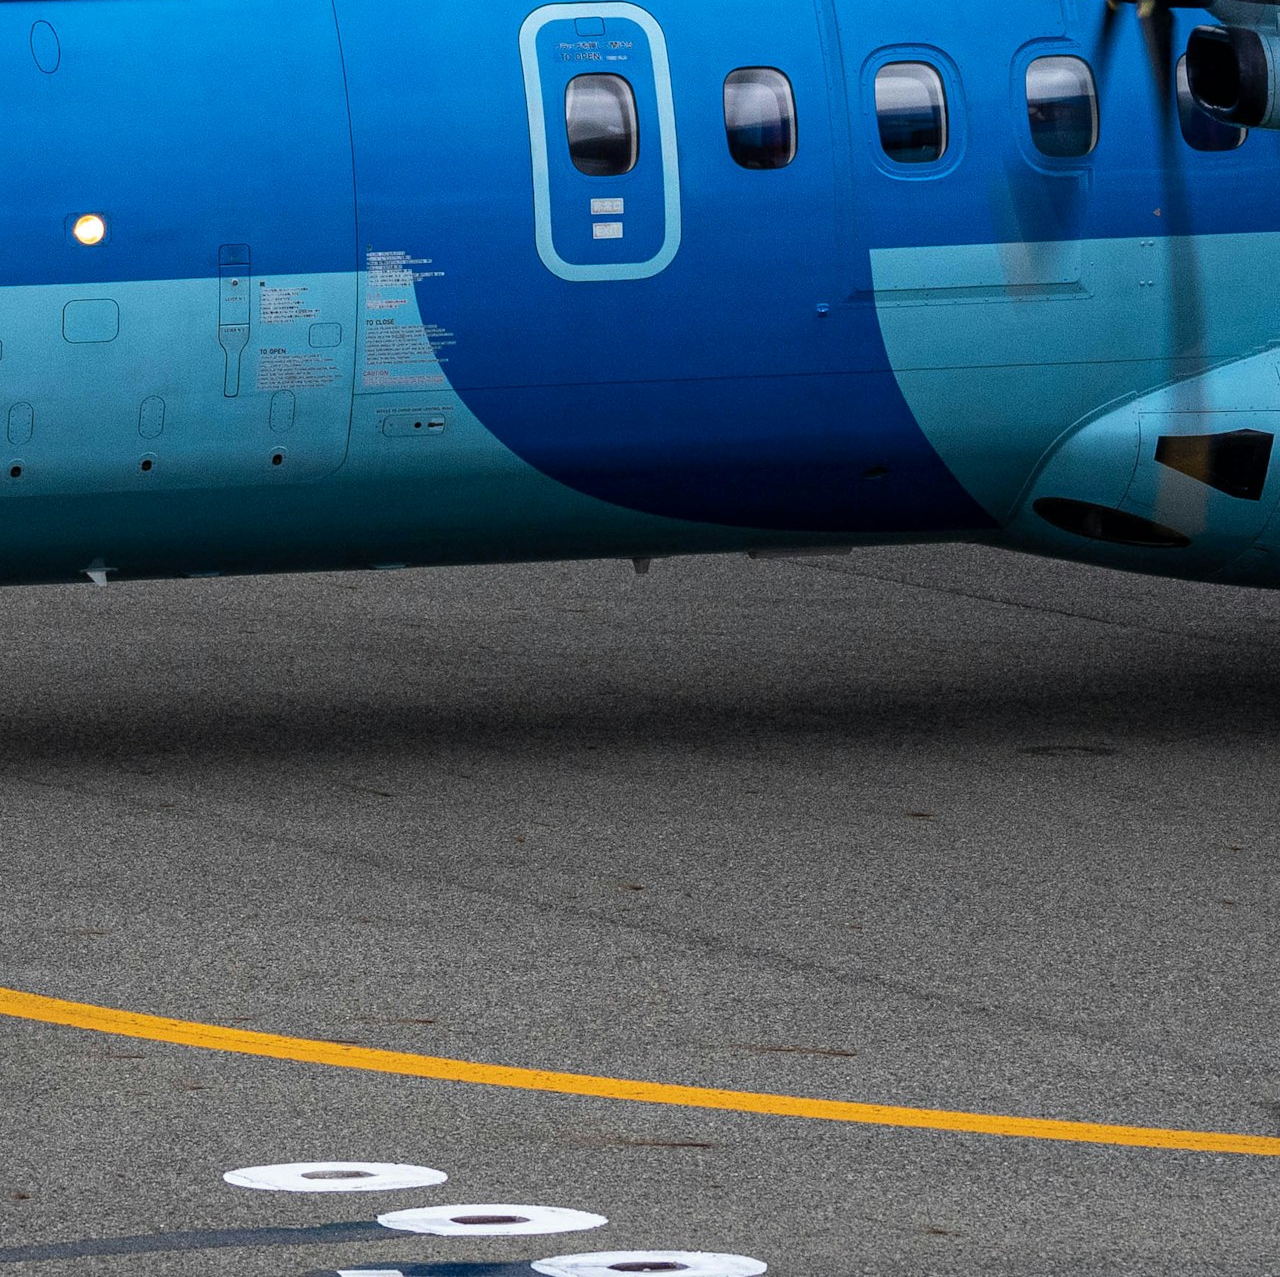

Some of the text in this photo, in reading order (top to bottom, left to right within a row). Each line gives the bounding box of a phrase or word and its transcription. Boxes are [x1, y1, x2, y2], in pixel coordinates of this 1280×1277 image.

[560, 53, 571, 61] TO
[575, 52, 601, 61] OPEN
[596, 225, 621, 236] EXIT
